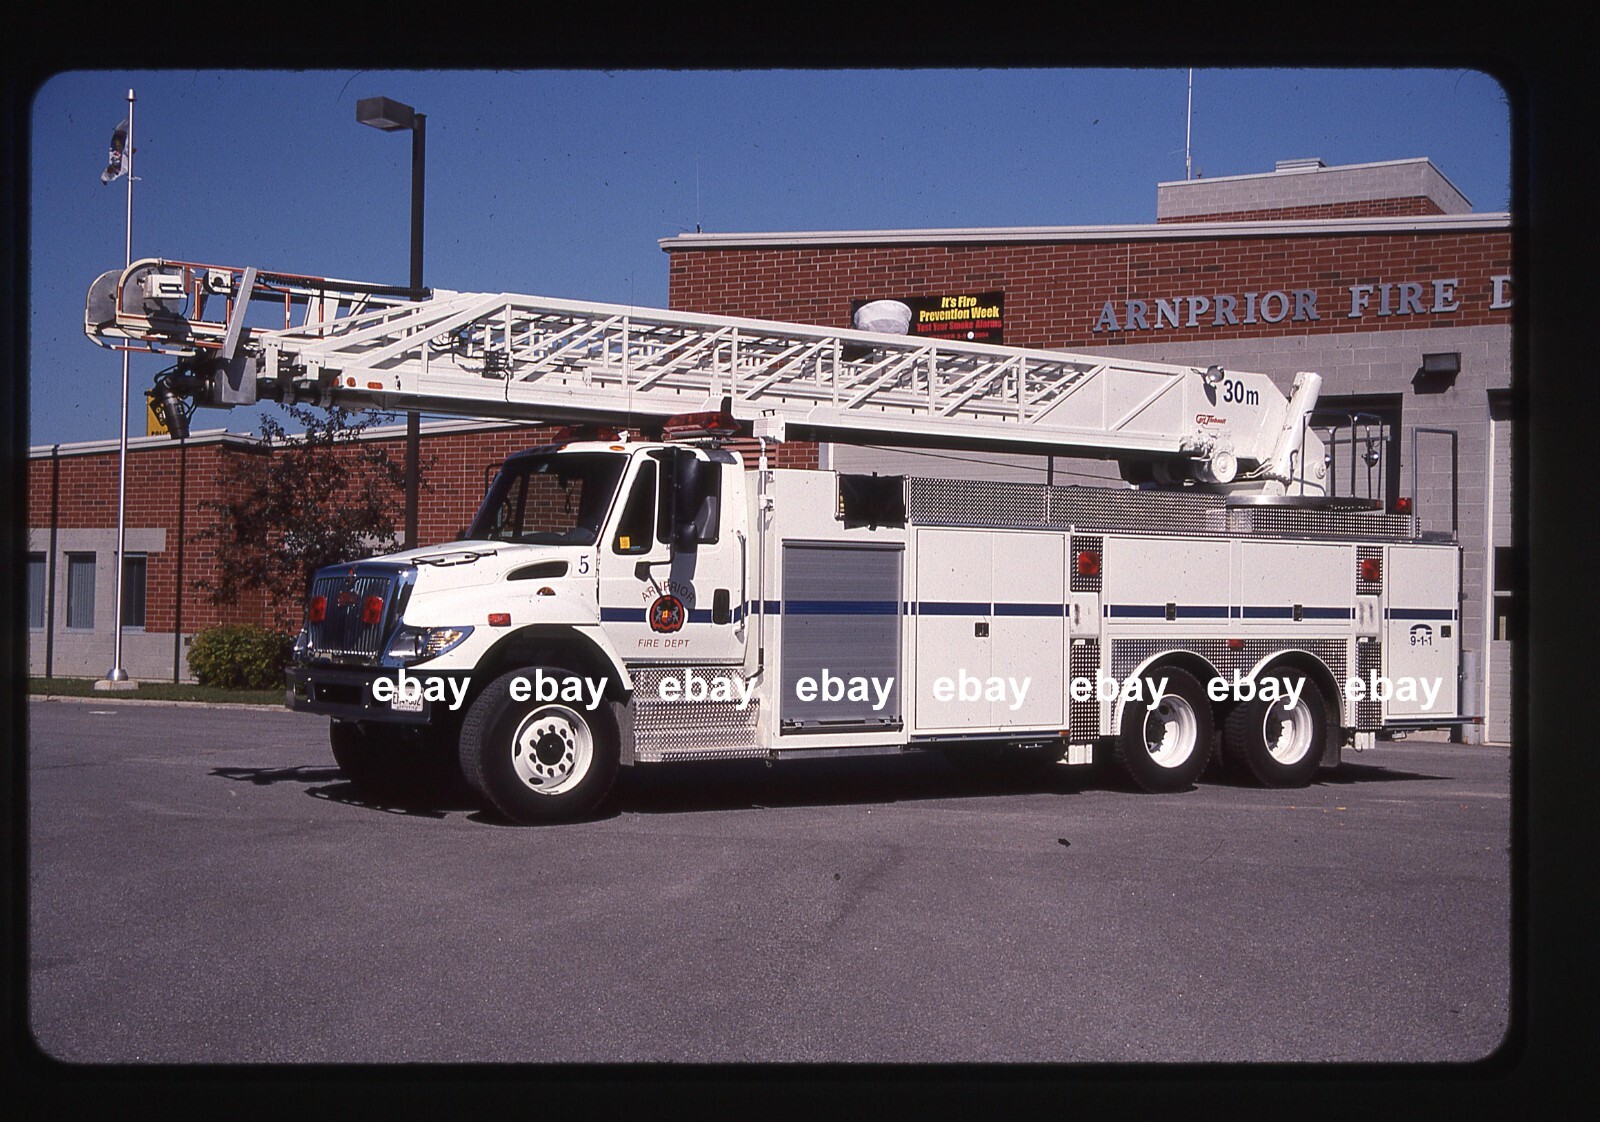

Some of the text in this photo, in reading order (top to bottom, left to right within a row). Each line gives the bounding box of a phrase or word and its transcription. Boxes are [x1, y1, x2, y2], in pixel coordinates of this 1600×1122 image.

[941, 296, 977, 308] It's Fire
[1092, 289, 1320, 332] ARNPRIOR
[1347, 278, 1461, 318] FIRE
[919, 306, 1000, 322] Prevention Week
[917, 319, 1002, 332] Test Your Smoke Alarms
[578, 555, 590, 574] 5
[637, 639, 690, 648] FIRE DEPT
[1410, 635, 1432, 646] 9-1-1
